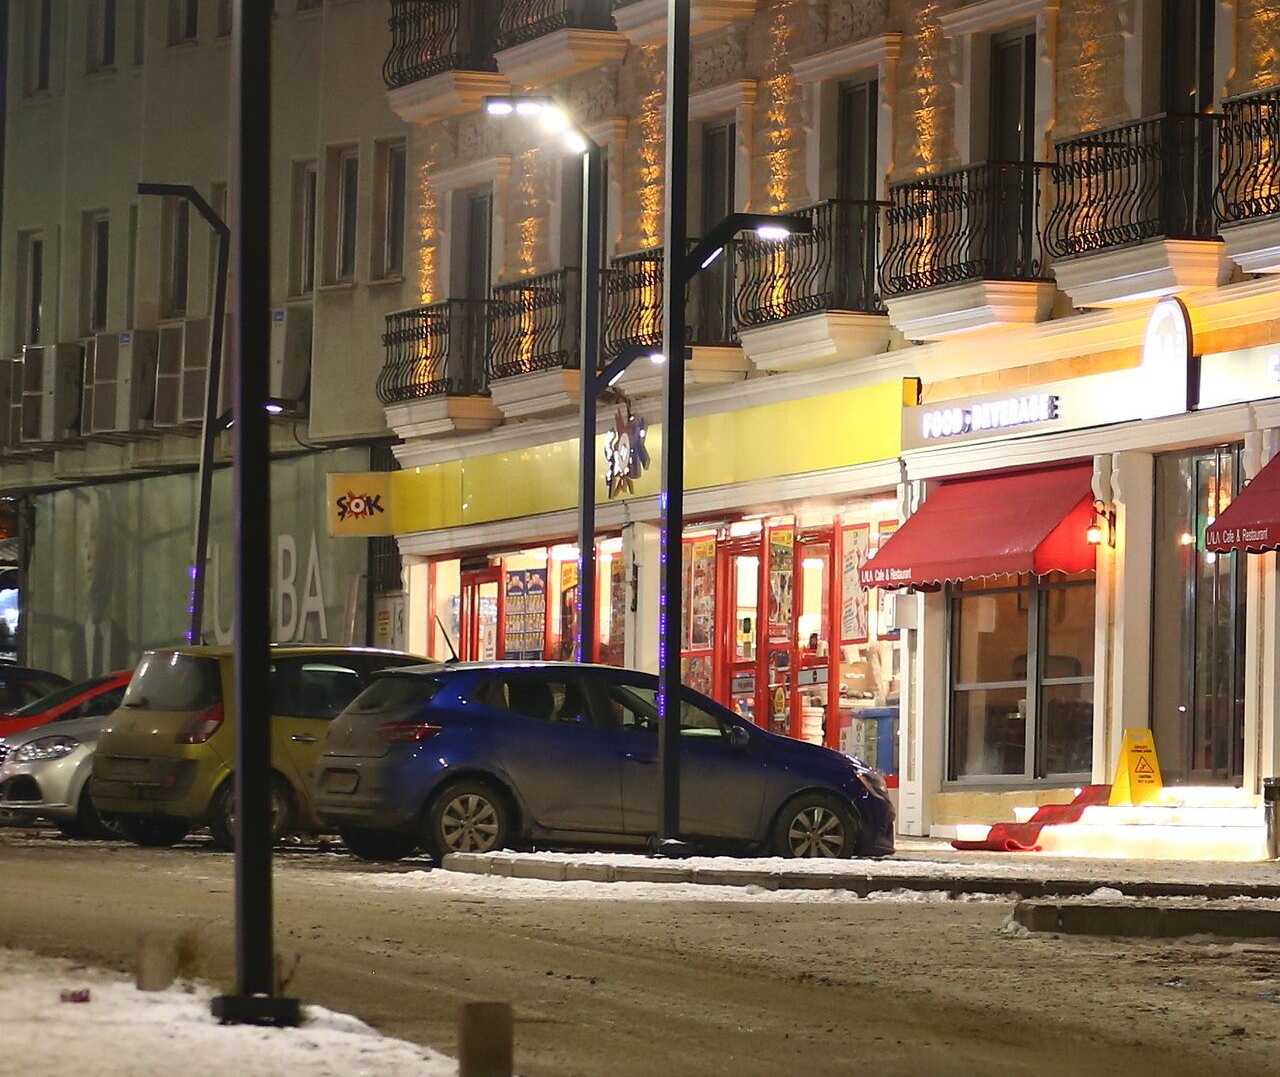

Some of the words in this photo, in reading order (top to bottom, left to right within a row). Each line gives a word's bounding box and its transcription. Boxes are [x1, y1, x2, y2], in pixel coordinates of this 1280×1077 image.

[922, 407, 964, 439] FOOD
[1222, 529, 1235, 543] Cafe
[1242, 527, 1268, 541] Restaurant
[875, 569, 885, 581] Cafe
[890, 567, 912, 580] Restaurant
